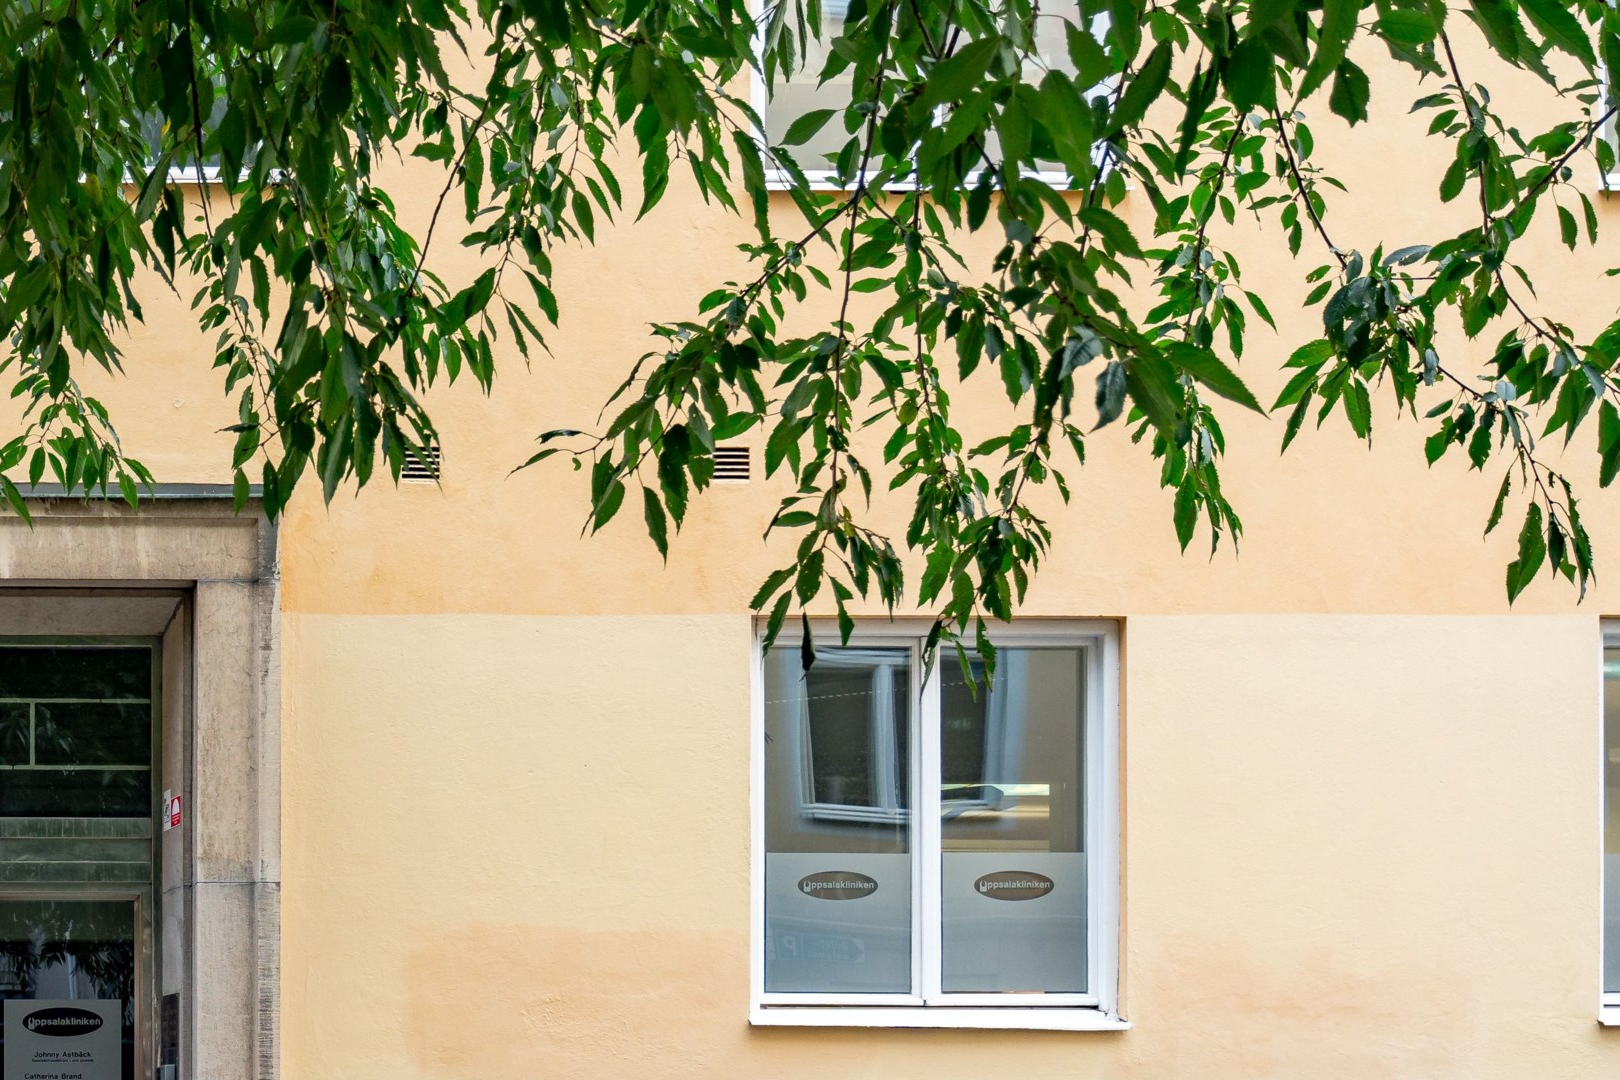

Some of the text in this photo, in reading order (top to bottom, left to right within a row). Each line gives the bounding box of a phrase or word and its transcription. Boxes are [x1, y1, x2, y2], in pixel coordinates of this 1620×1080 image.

[803, 880, 875, 893] Uppsalakliniken
[979, 880, 1051, 893] Uppsalakliniken
[27, 1017, 101, 1030] Uppsalakliniken
[34, 1051, 60, 1059] Johnny
